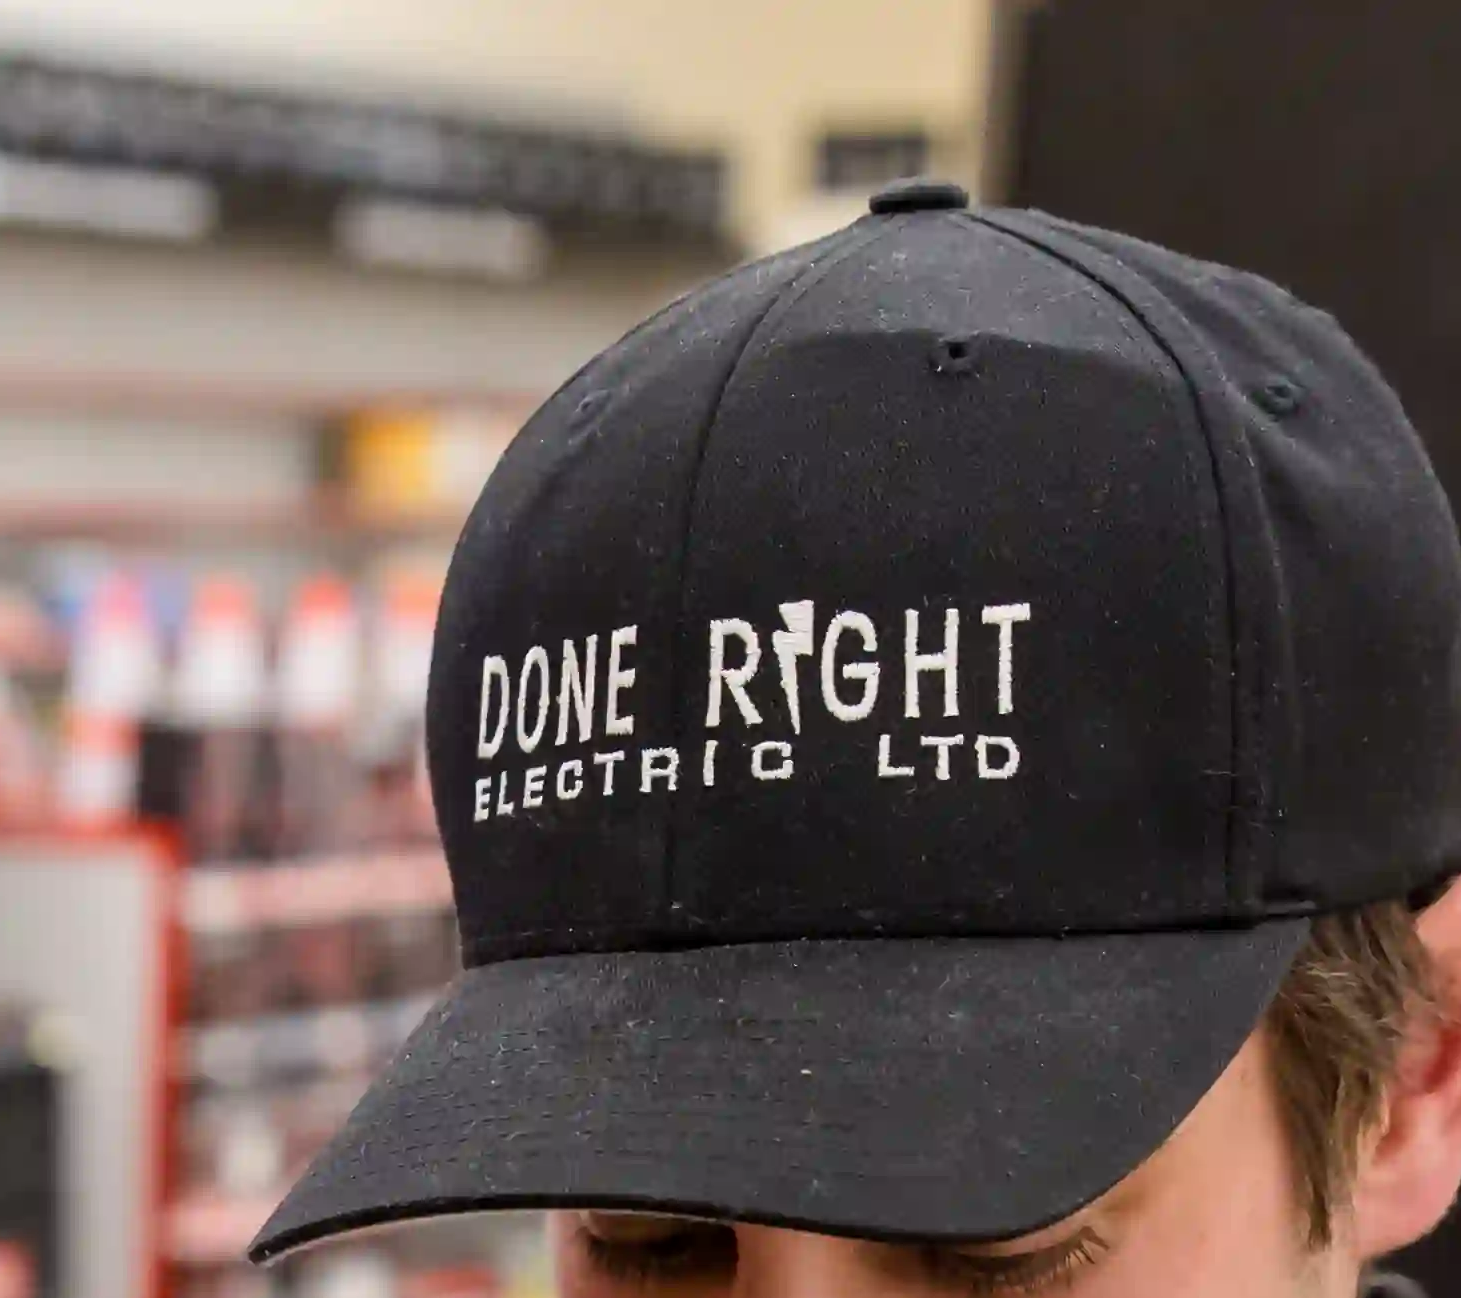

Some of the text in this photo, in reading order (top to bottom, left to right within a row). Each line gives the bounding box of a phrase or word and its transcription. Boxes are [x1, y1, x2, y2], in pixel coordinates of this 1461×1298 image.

[478, 600, 1031, 759] DONE RIGHT
[473, 734, 1022, 823] ELECTRIC LTD
